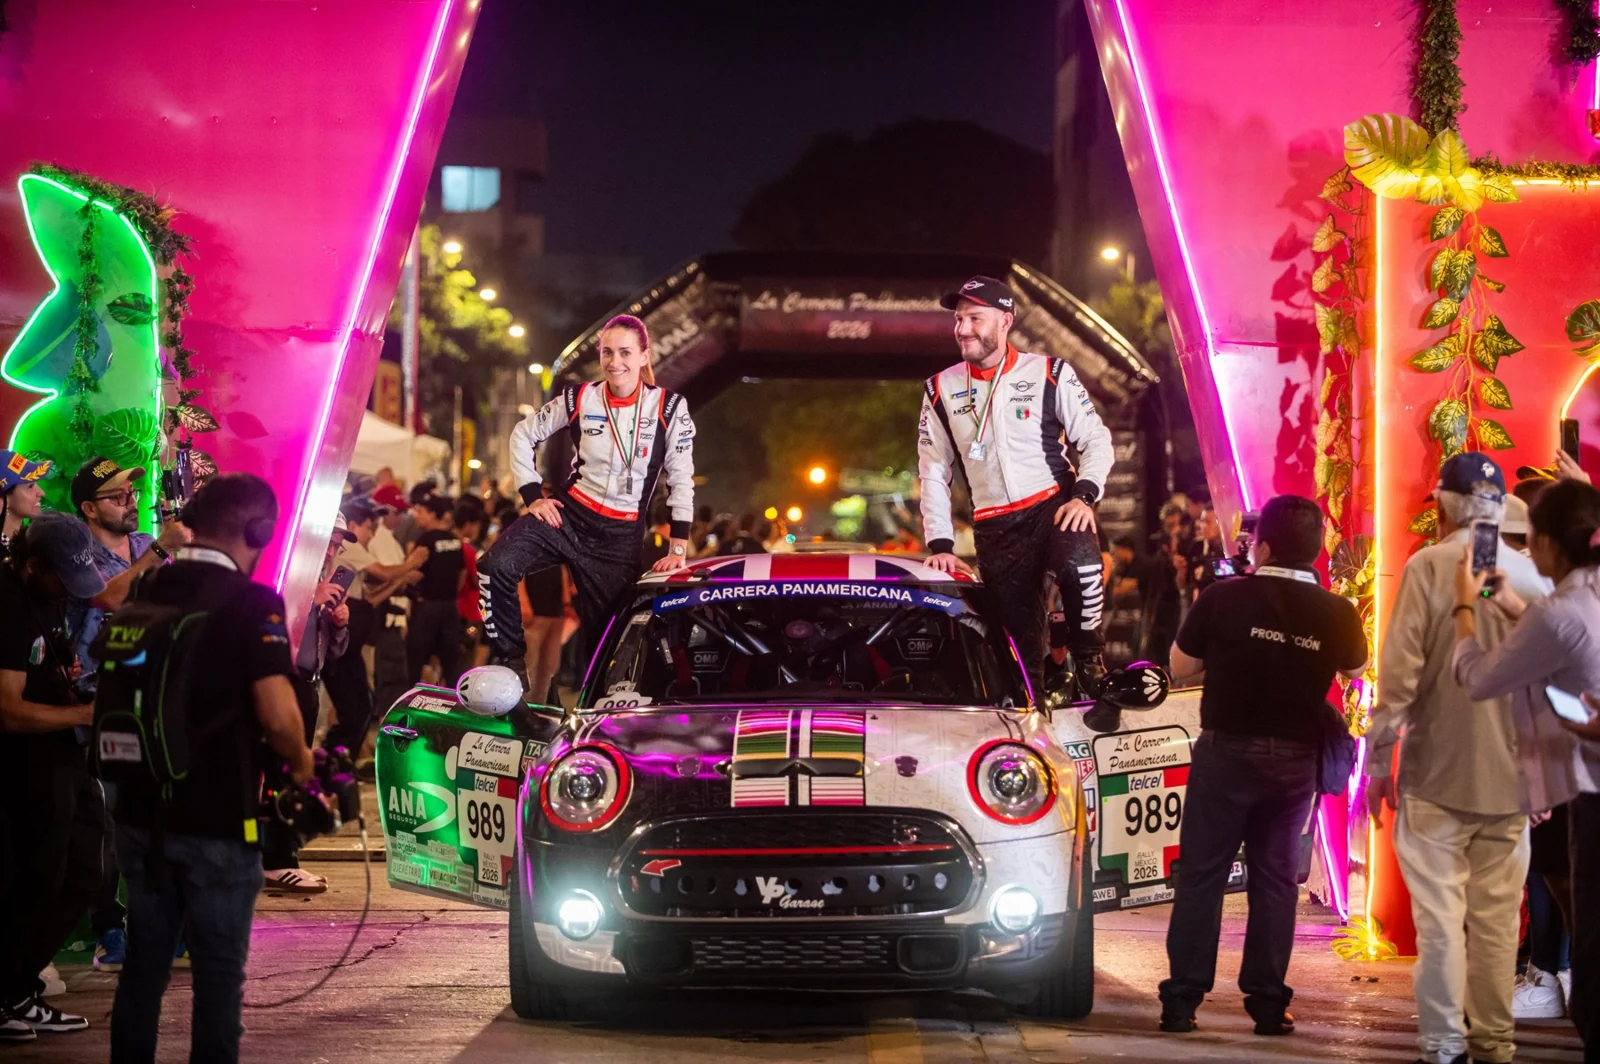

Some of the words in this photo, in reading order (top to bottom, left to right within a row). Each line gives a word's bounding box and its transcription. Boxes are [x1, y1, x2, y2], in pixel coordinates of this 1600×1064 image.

[751, 291, 777, 310] La
[660, 595, 690, 608] telcel
[699, 584, 778, 601] CARRERA
[782, 583, 912, 602] PANAMERICANA
[923, 595, 953, 608] telcel
[1077, 563, 1104, 631] MINI
[476, 571, 499, 639] MINI
[109, 626, 146, 642] TVU
[1250, 626, 1321, 651] PRODUCIÓN
[907, 640, 933, 652] OMP
[694, 653, 719, 665] OMP
[472, 736, 483, 750] La
[484, 738, 512, 755] Carrera
[1114, 737, 1130, 752] La
[1134, 734, 1171, 752] Carrera
[475, 776, 498, 793] telcel
[1129, 774, 1162, 791] telcel
[388, 786, 427, 820] ANA
[388, 813, 417, 825] SEGUROS
[467, 800, 505, 843] 989
[1125, 792, 1182, 836] 989
[1137, 850, 1155, 859] RALLY
[482, 867, 499, 882] 2026
[1134, 865, 1158, 880] 2026
[1093, 887, 1115, 900] AWEI
